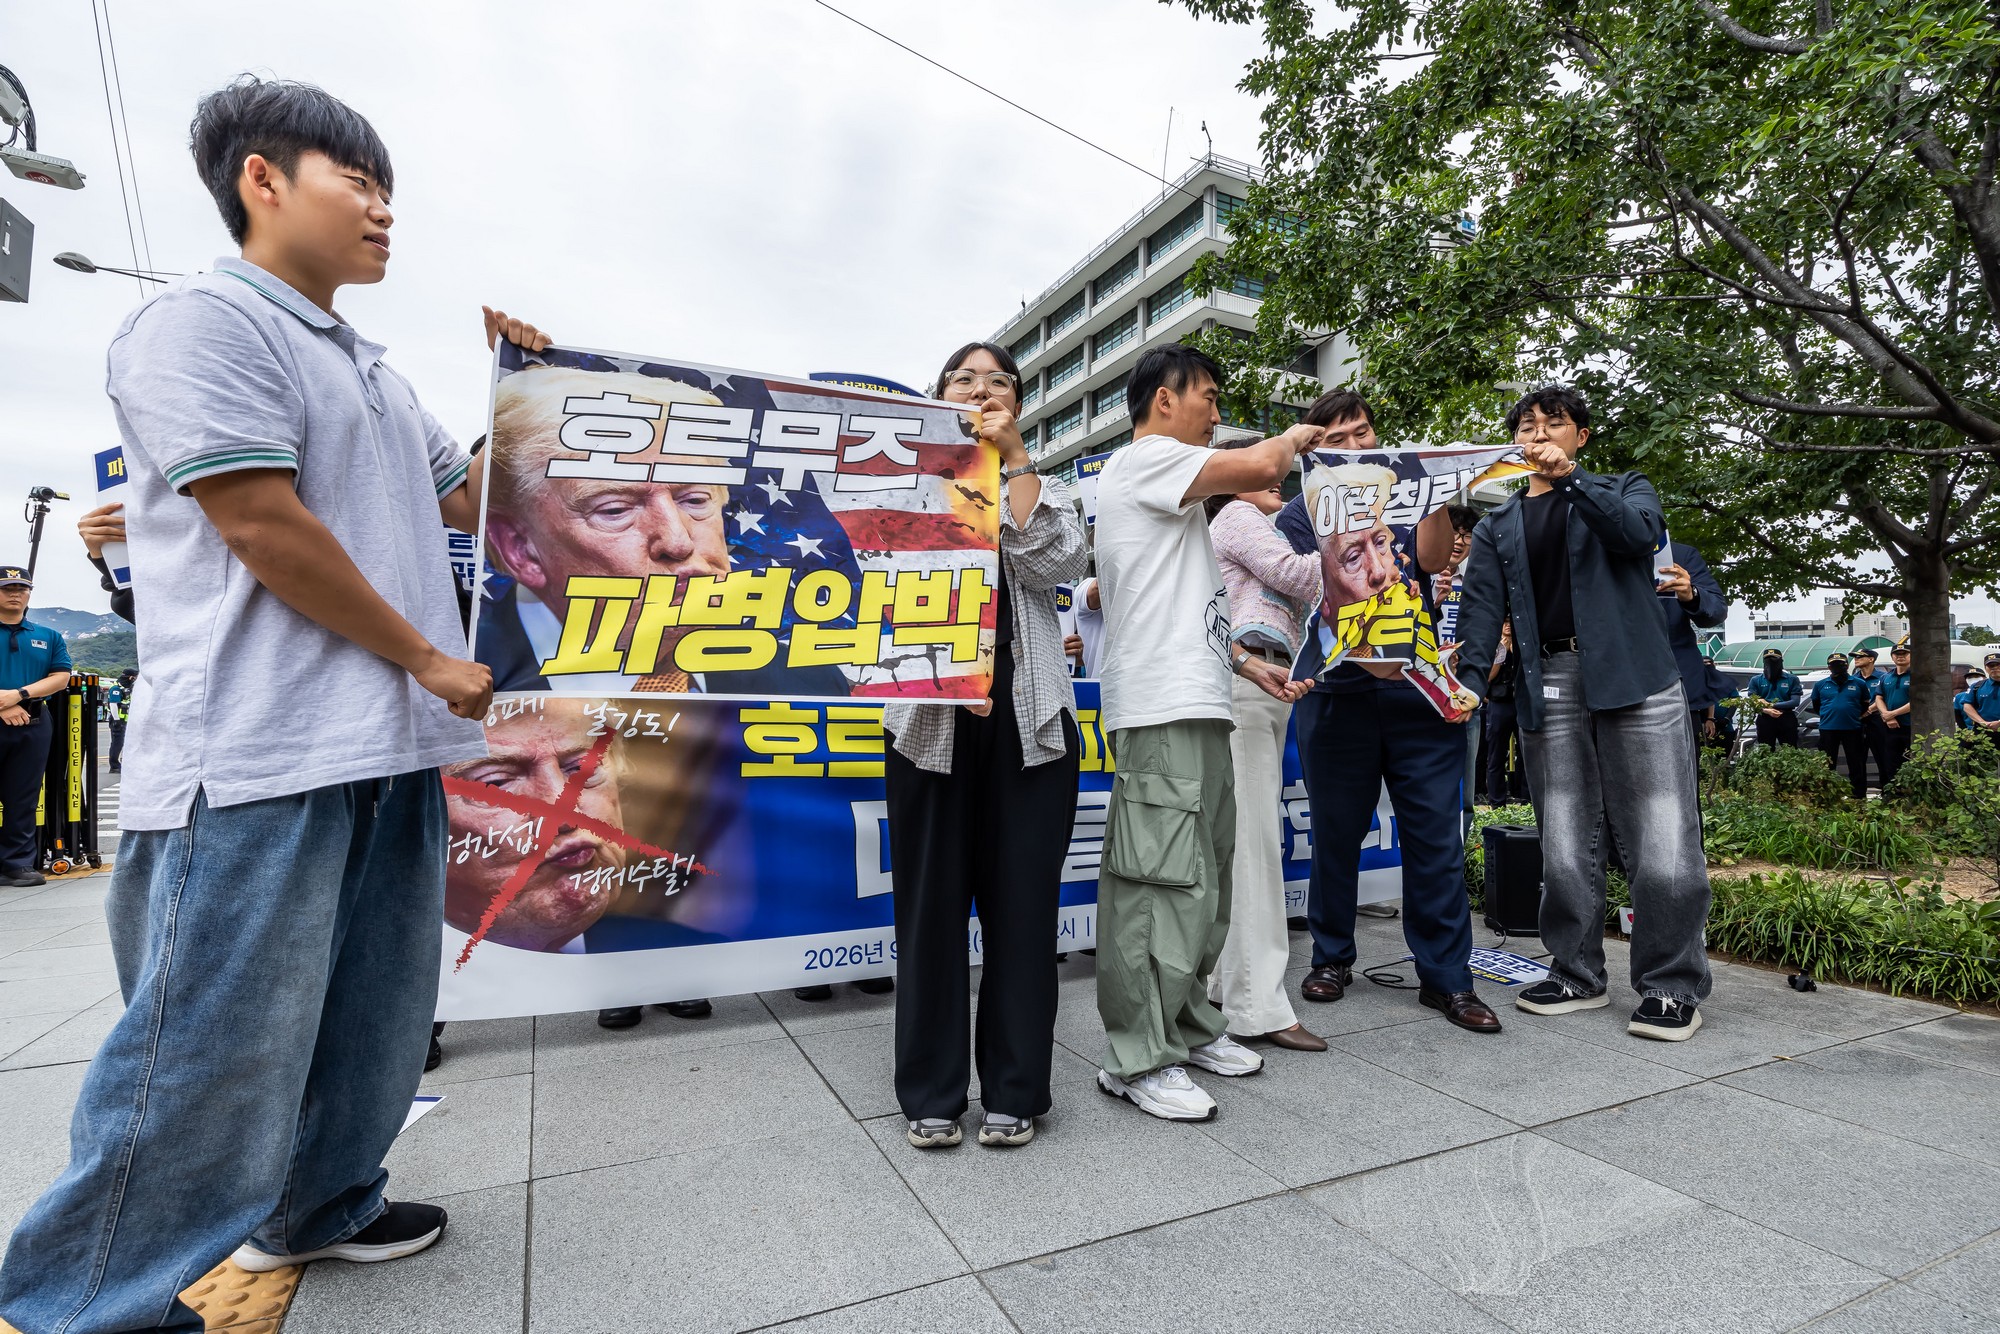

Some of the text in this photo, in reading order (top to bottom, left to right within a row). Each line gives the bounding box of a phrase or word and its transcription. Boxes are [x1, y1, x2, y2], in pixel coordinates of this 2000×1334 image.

[545, 391, 925, 494] 호르무즈
[1316, 485, 1379, 537] 이란
[539, 566, 992, 676] 파병압박
[72, 718, 80, 766] POLICE
[583, 701, 681, 743] 날강도!
[569, 853, 696, 896] 경제수탈!
[804, 940, 883, 971] 2026년
